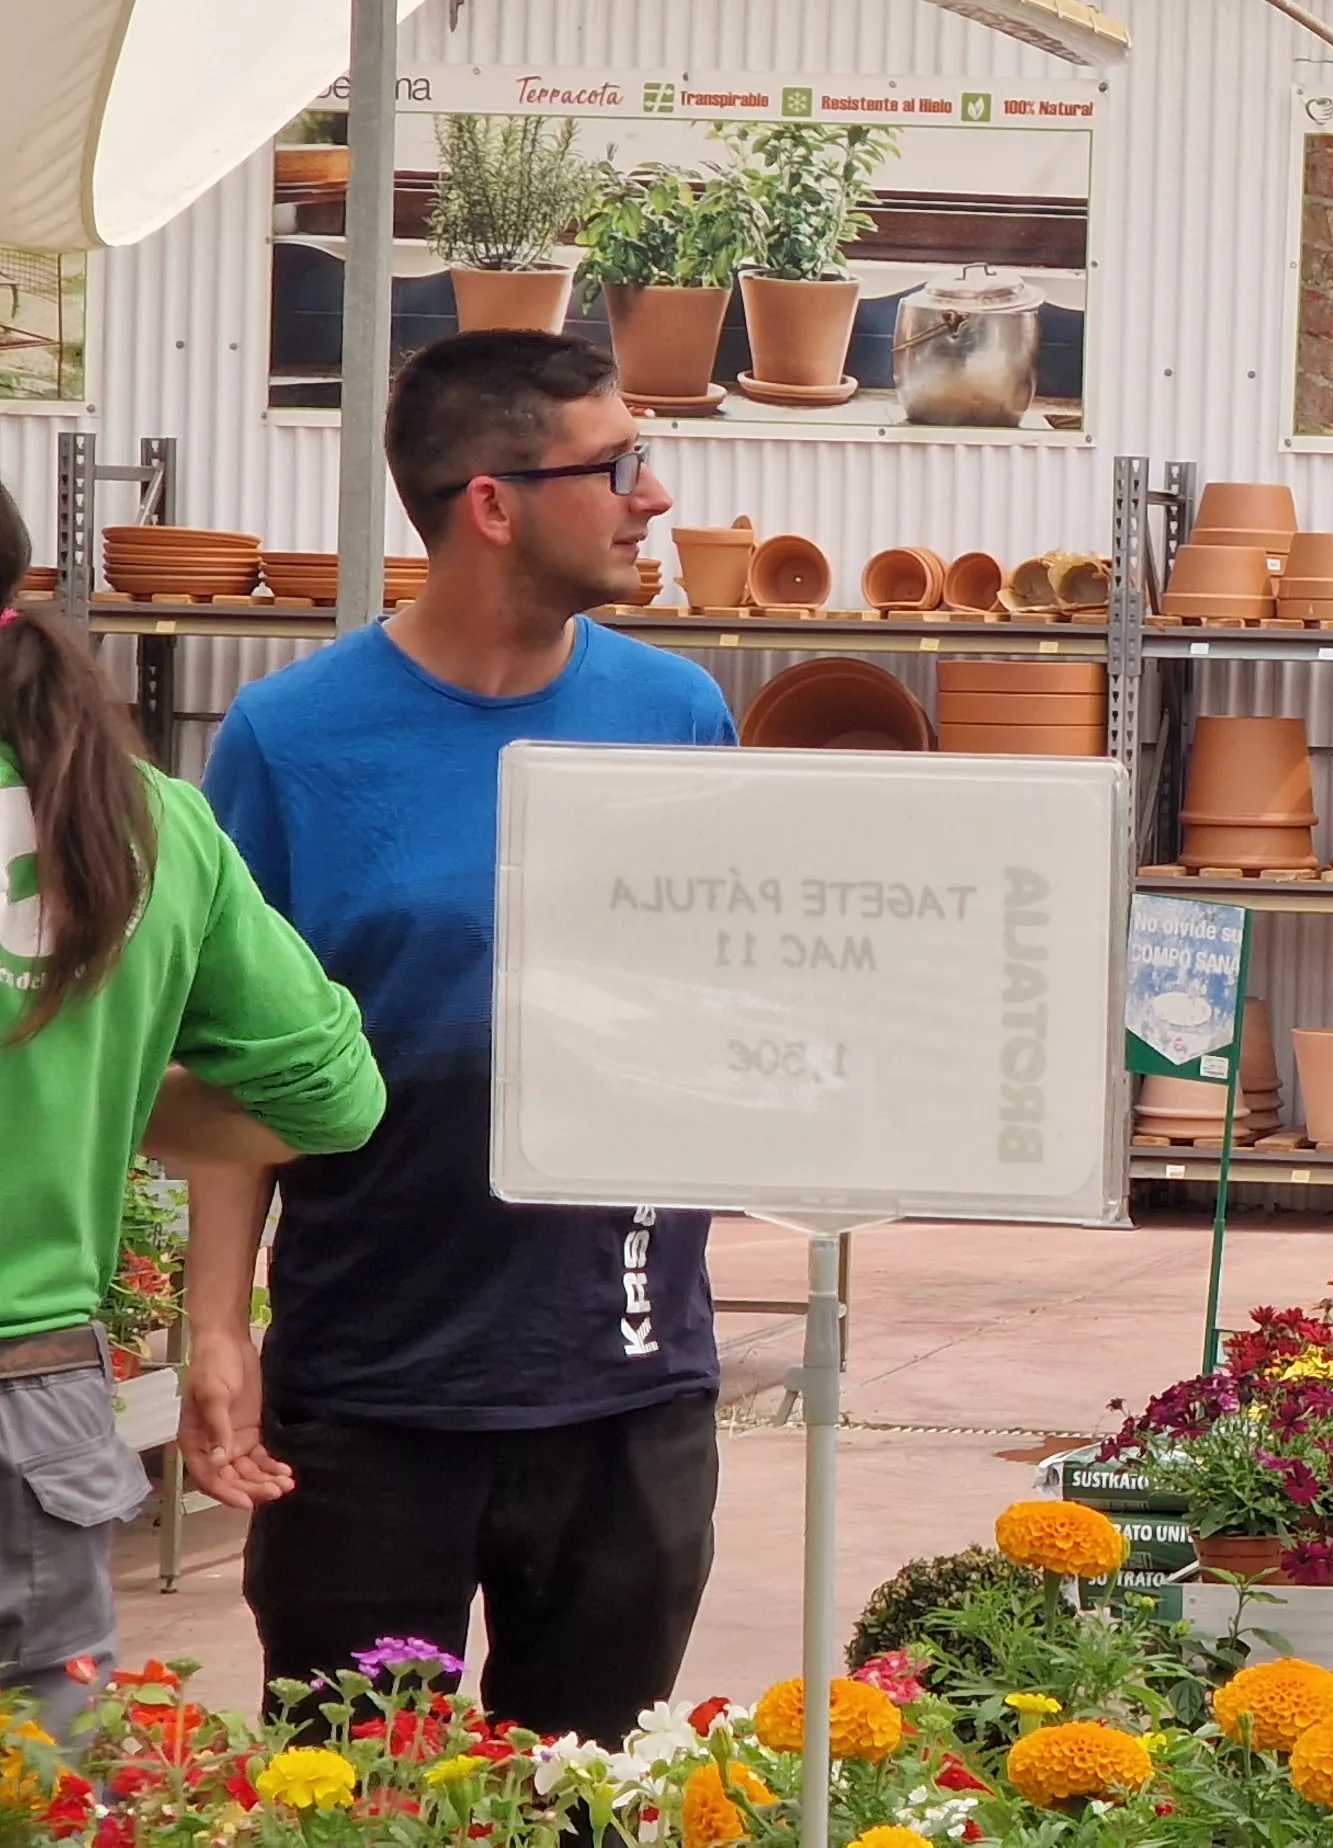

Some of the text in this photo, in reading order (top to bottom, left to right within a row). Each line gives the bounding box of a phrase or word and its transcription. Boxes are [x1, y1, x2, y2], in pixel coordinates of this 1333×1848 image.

[516, 75, 623, 106] Terracota
[680, 91, 768, 109] Transpirable
[821, 95, 953, 114] Resistente al Hielo
[1003, 100, 1093, 117] 100% Natural
[1134, 912, 1243, 943] No olvide su
[1132, 943, 1191, 969] COMPO
